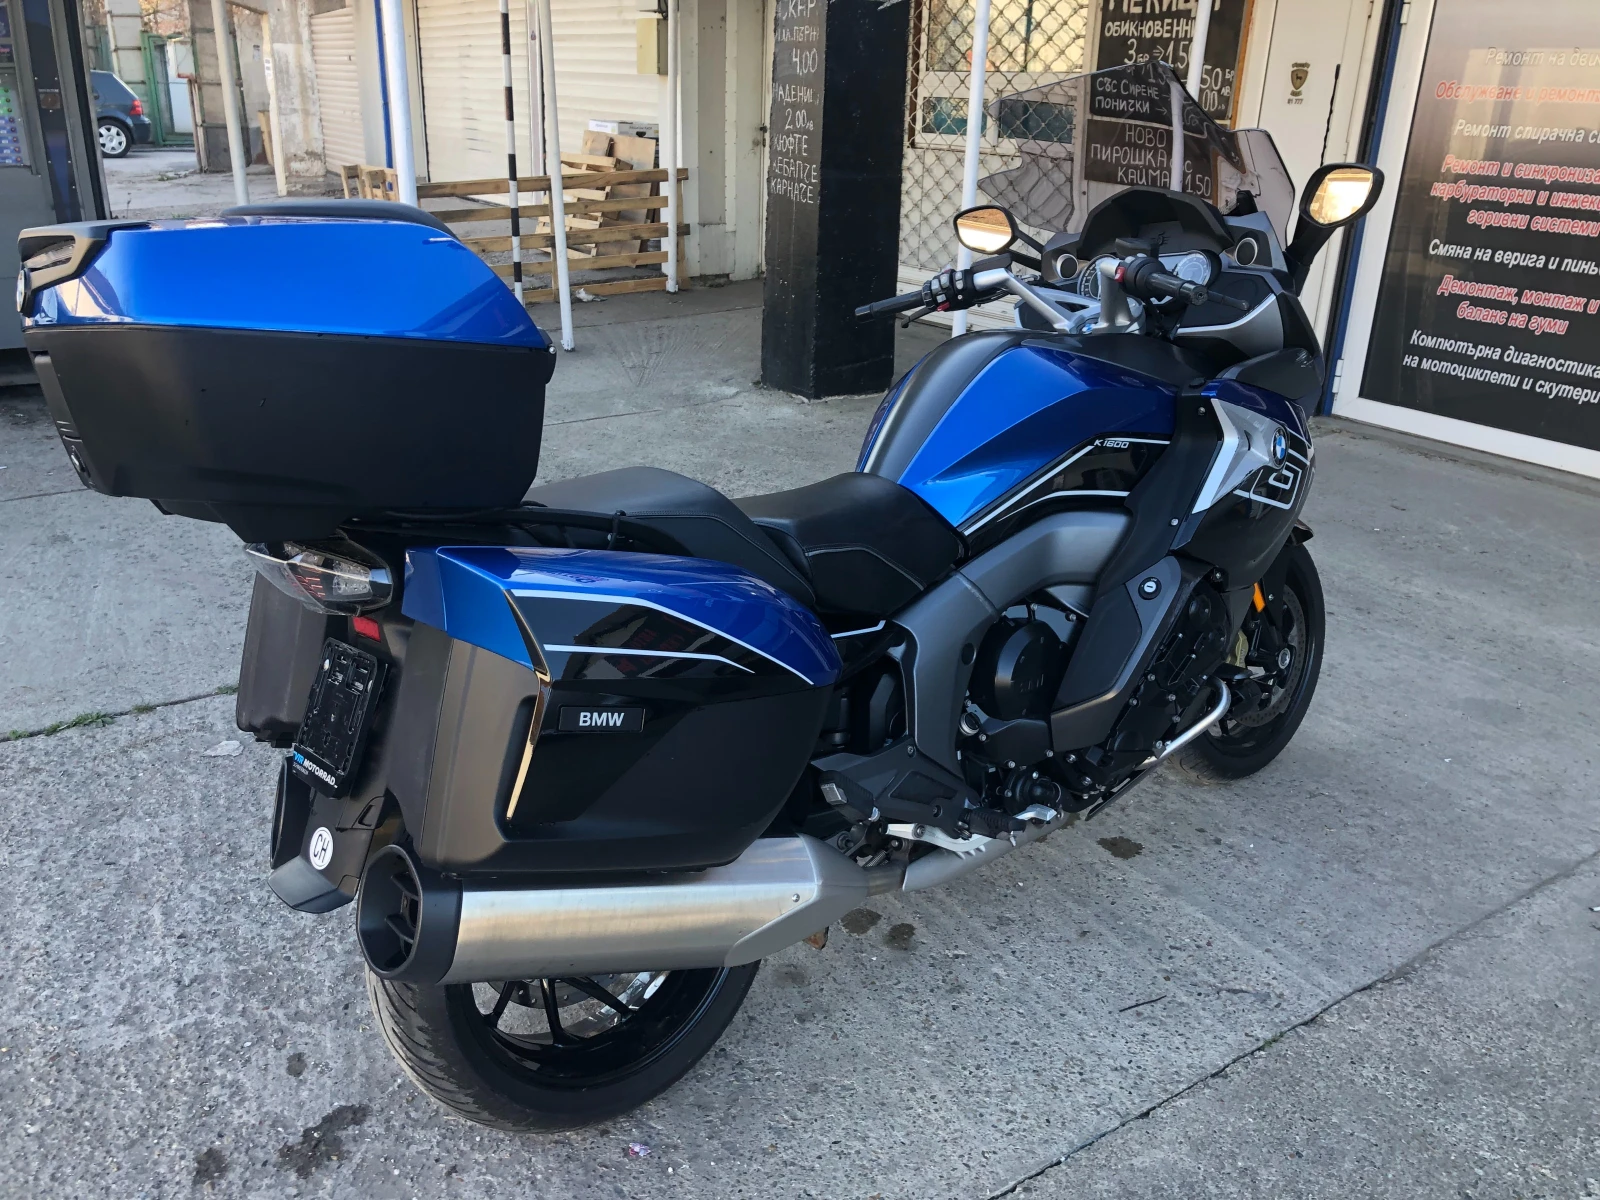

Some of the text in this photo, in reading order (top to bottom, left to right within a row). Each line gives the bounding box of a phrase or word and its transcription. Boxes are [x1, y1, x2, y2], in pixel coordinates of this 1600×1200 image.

[1485, 47, 1544, 66] Ремонт
[1548, 52, 1565, 66] на
[1435, 80, 1522, 103] Обслужване
[1525, 87, 1536, 100] и
[1126, 125, 1167, 147] НОВО
[1454, 119, 1511, 139] Ремонт
[1514, 125, 1585, 145] спирачна
[1091, 144, 1168, 168] ПИРОШКА
[1441, 154, 1600, 185] Ремонт и синхрониза
[1430, 180, 1536, 205] карбураторни
[1537, 190, 1549, 206] и
[1467, 209, 1600, 237] горивни системи
[1428, 238, 1600, 276] Смяна на верига и пинь
[1436, 274, 1600, 314] Демонтаж, монтаж и
[1456, 301, 1569, 335] баланс на гуми
[1410, 329, 1600, 379] Компютърна диагностика
[1403, 353, 1600, 405] на мотоциклети и скутери
[578, 711, 625, 727] BMW
[303, 758, 336, 786] MOTORRAD
[313, 833, 330, 863] CH
